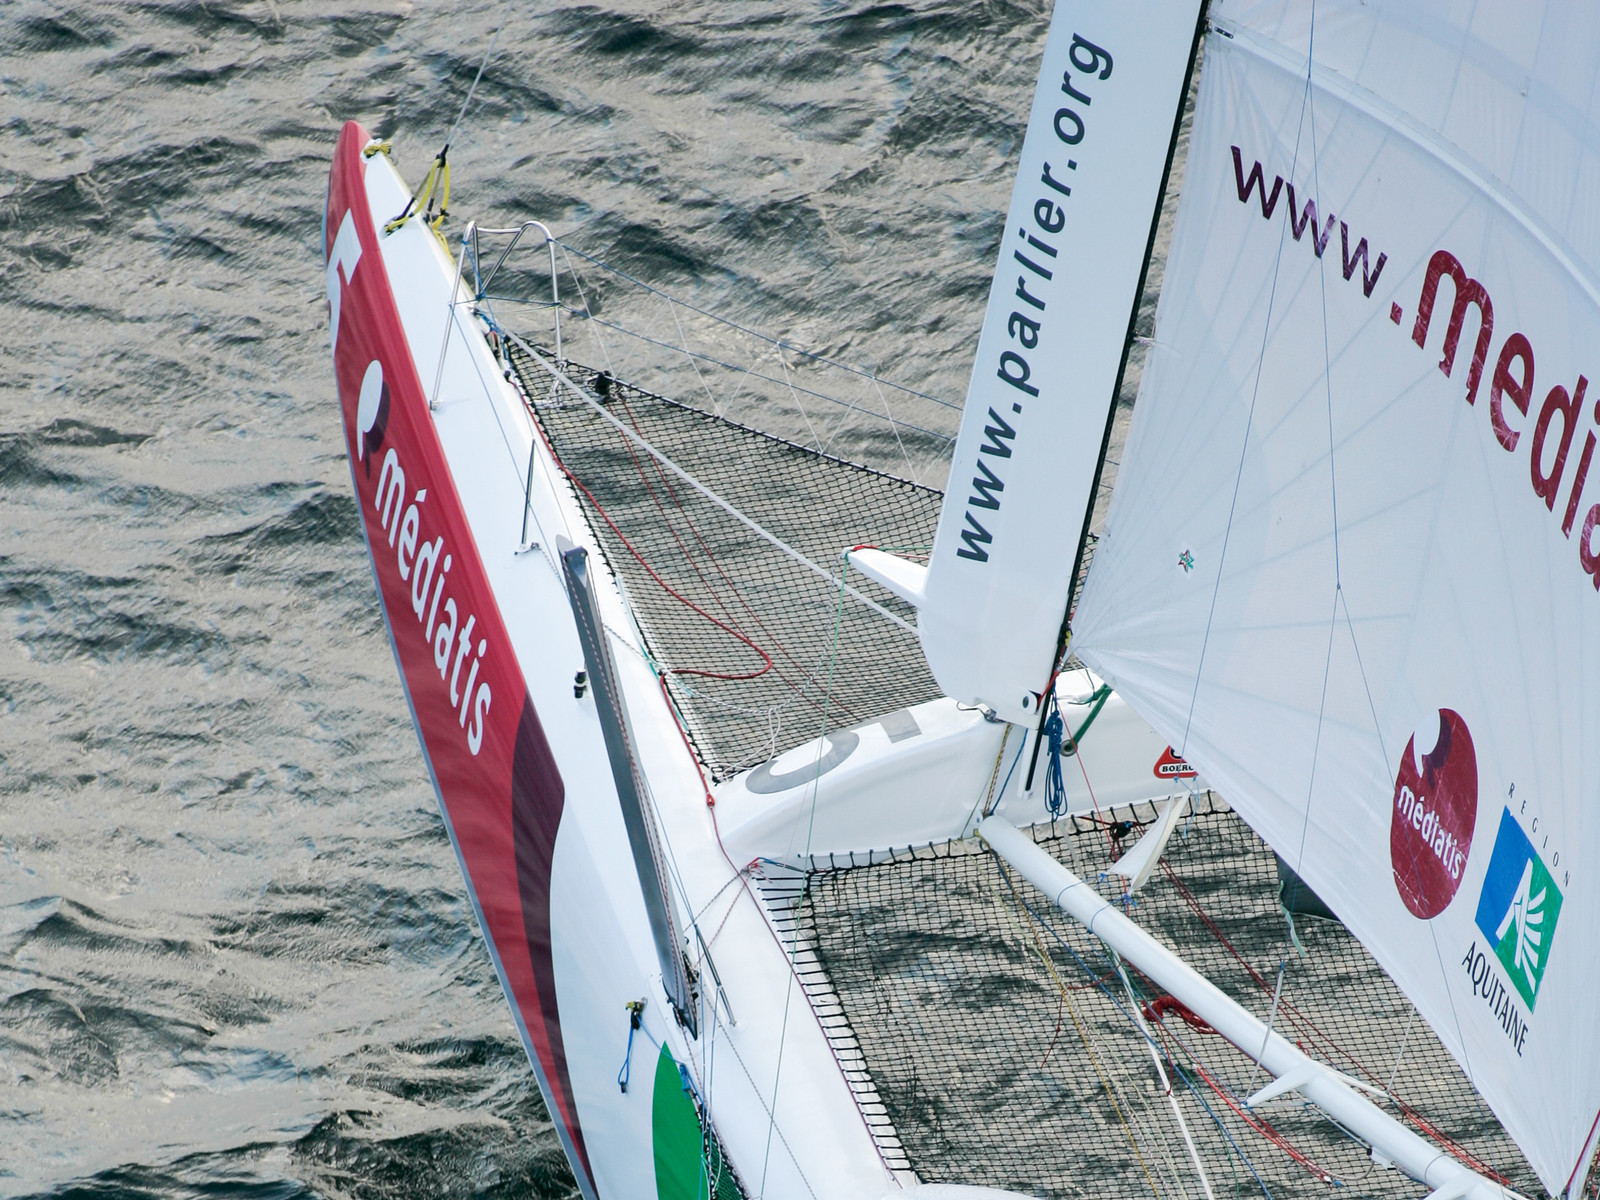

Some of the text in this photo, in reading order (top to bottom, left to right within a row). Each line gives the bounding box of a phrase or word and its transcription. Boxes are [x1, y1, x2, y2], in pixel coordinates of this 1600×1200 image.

[956, 32, 1114, 564] www.parlier.org
[374, 447, 492, 756] médiatis
[1397, 783, 1463, 881] médiatis
[1508, 782, 1571, 888] REGION
[1461, 940, 1529, 1058] AQUITAINE
